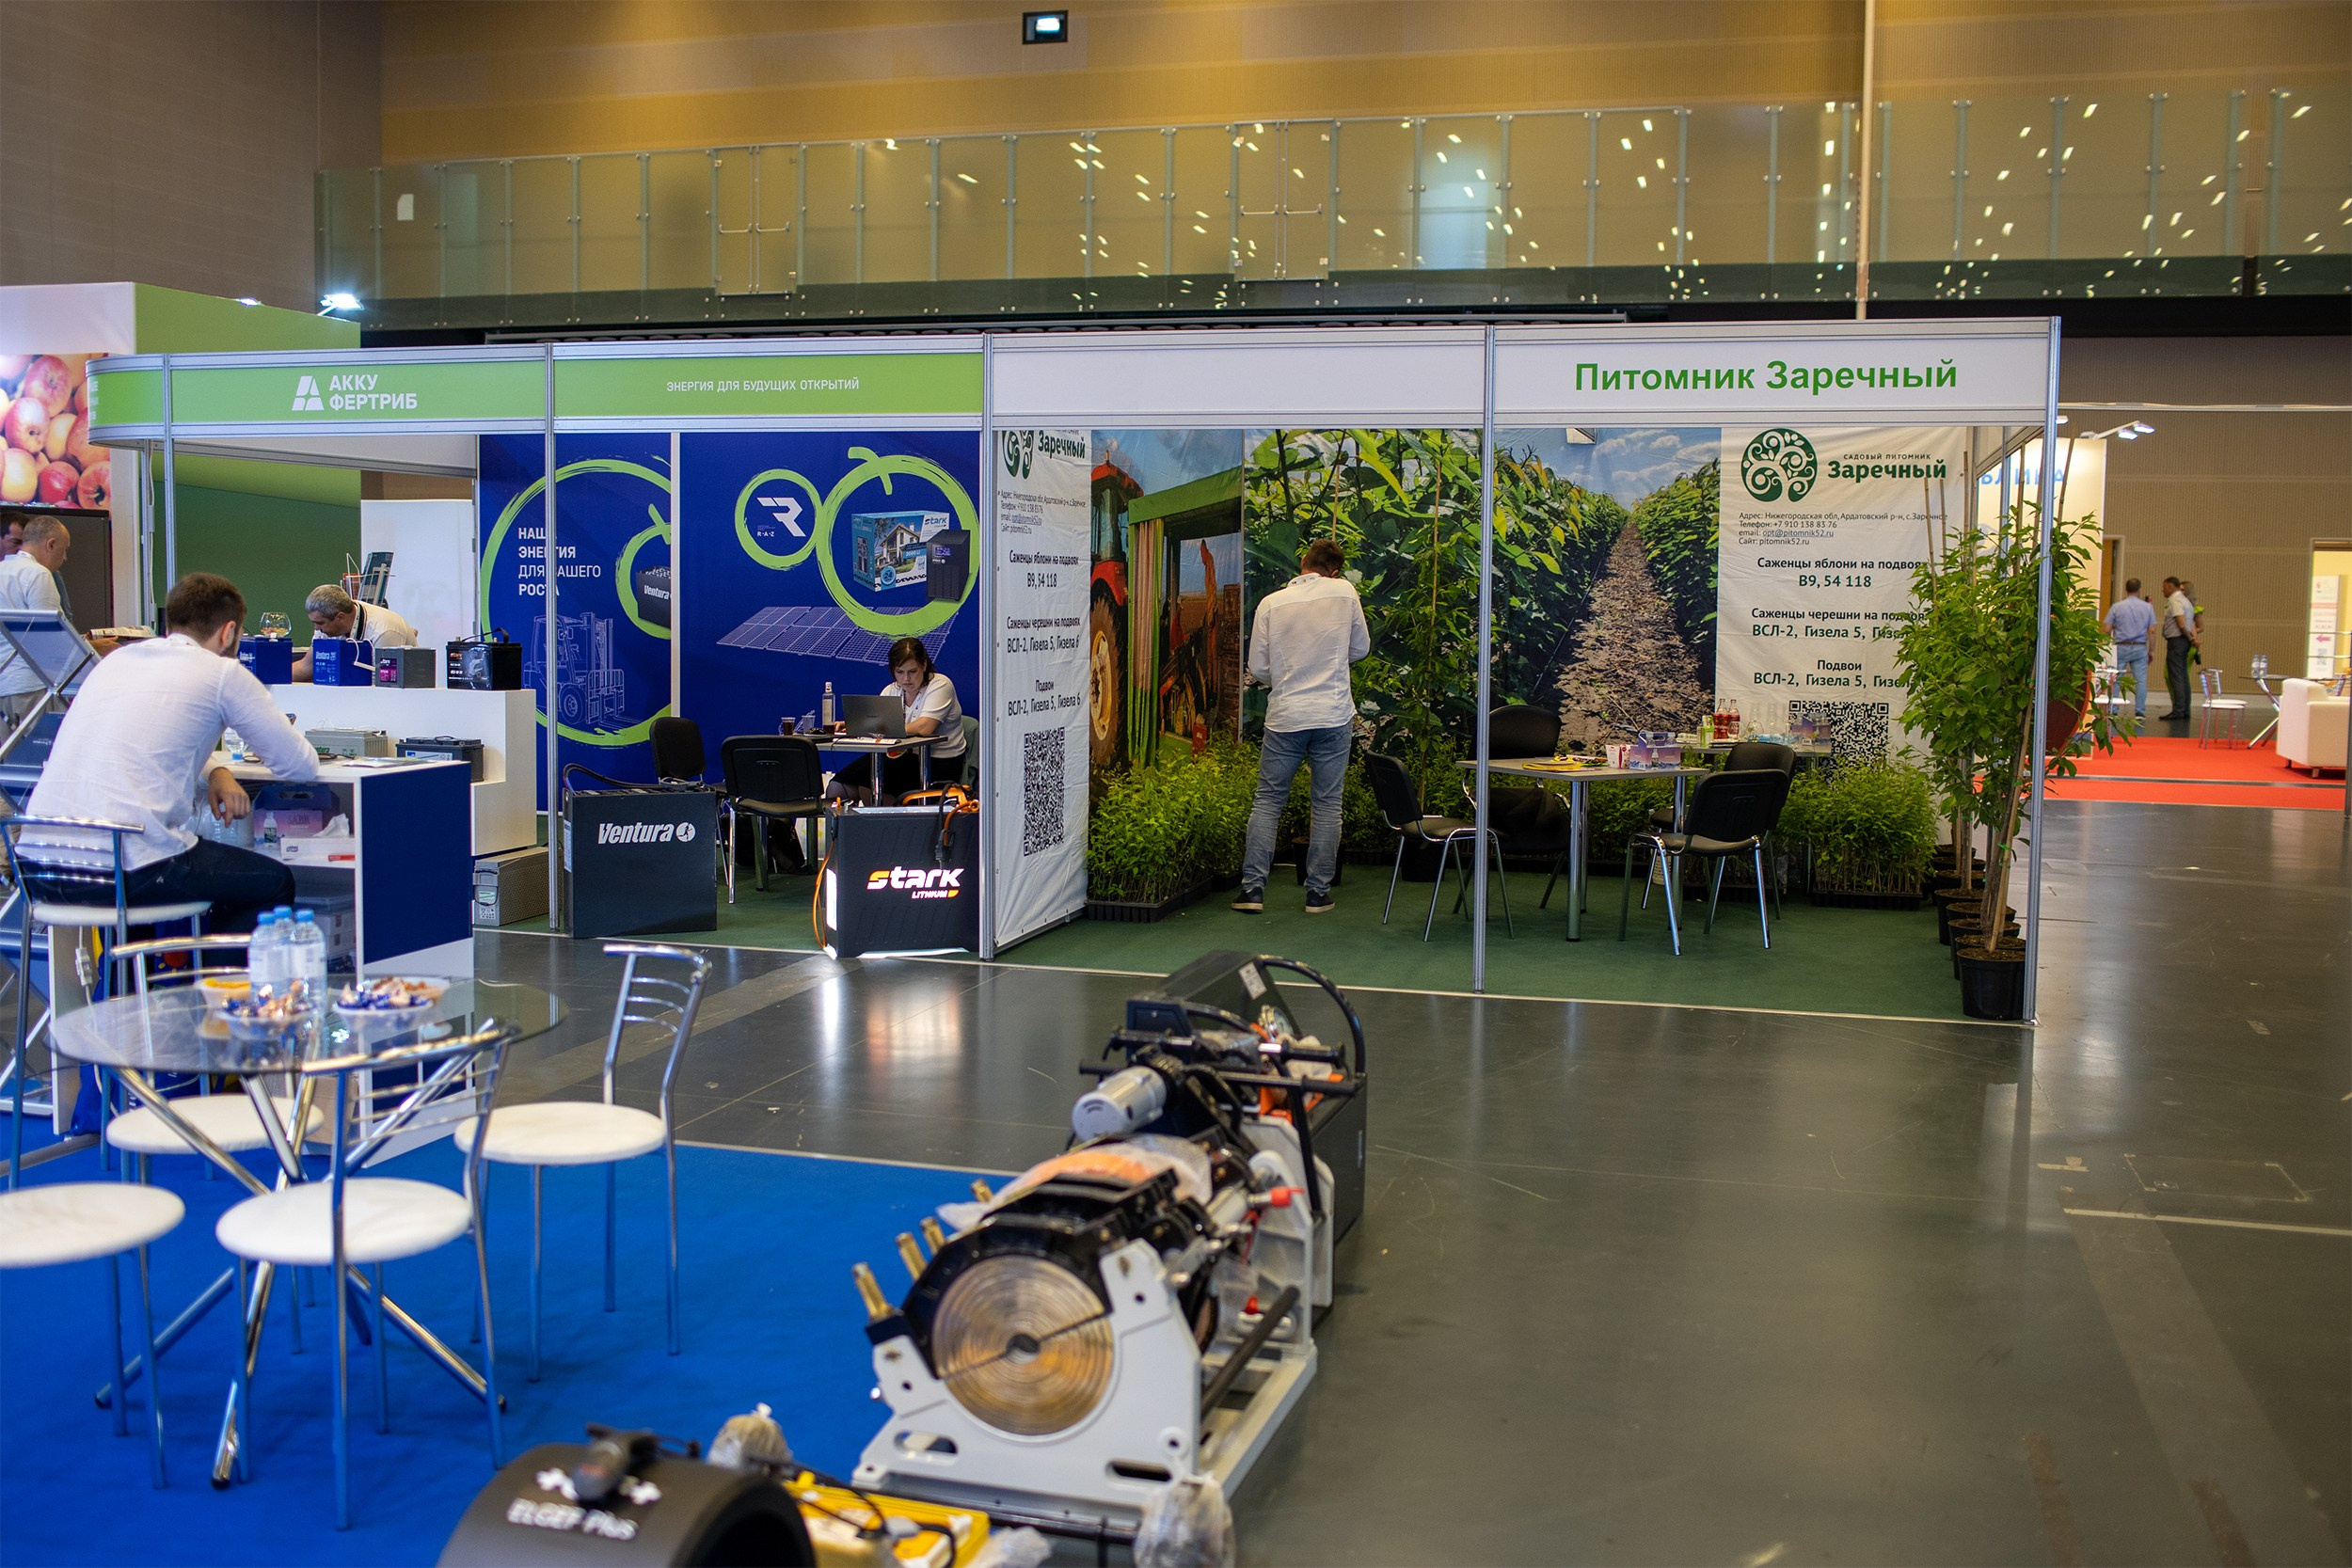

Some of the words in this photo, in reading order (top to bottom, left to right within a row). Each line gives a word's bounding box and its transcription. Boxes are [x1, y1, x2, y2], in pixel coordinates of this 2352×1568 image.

[329, 374, 378, 390] АККУ
[666, 381, 714, 392] ЭНЕРГИЯ
[717, 380, 739, 392] ДЛЯ
[743, 380, 797, 392] БУДУЩИХ
[800, 376, 859, 390] ОТКРЫТИЙ
[1575, 363, 1756, 390] Питомник
[1766, 358, 1957, 395] Заречный
[329, 392, 418, 410] ФЕРТРИБ
[1038, 430, 1086, 458] Заречный
[1827, 459, 1947, 483] Заречный
[1739, 512, 1763, 520] Адрес:
[1765, 512, 1823, 521] Нижегородская
[1823, 512, 1839, 521] обл,
[1840, 513, 1889, 521] Ардатовский
[1890, 514, 1905, 522] р-н,
[1739, 520, 1772, 530] Телефон:
[1773, 520, 1784, 529] +7
[1827, 520, 1837, 529] 76
[518, 527, 558, 540] НАШ
[1739, 529, 1761, 537] email:
[1762, 529, 1835, 538] opt@pitomnik52.ru
[1739, 537, 1758, 546] Сайт:
[1759, 537, 1810, 546] pitomnik52.ru
[1009, 549, 1033, 564] Саженцы
[1033, 551, 1052, 564] яблони
[1052, 556, 1059, 565] на
[1059, 555, 1079, 566] подвоях
[1757, 557, 1812, 570] Саженцы
[1814, 558, 1858, 570] яблони
[1860, 560, 1875, 569] на
[518, 564, 545, 578] ДЛЯ
[556, 564, 602, 578] АШЕГО
[1046, 572, 1057, 588] 118
[1823, 576, 1841, 587] 54
[1846, 576, 1872, 588] 118
[644, 583, 670, 600] Ventura
[1751, 608, 1805, 621] Саженцы
[1808, 610, 1861, 623] черешни
[1864, 611, 1878, 621] на
[1007, 616, 1031, 629] Саженцы
[1031, 617, 1053, 633] черешни
[1054, 618, 1060, 627] на
[1060, 616, 1081, 629] подвоях
[1752, 625, 1799, 639] ВСЛ-2,
[1804, 625, 1849, 638] Гизела
[1853, 624, 1866, 640] 5,
[1007, 638, 1028, 654] ВСЛ-2,
[1030, 637, 1049, 652] Гизела
[1050, 636, 1056, 652] 5,
[1057, 635, 1075, 650] Гизела
[1075, 635, 1080, 648] 6
[1817, 659, 1863, 673] Подвои
[1035, 679, 1055, 693] Подвои
[1753, 672, 1800, 688] ВСЛ-2,
[1805, 673, 1851, 687] Гизела
[1854, 673, 1867, 689] 5,
[1008, 699, 1028, 717] ВСЛ-2,
[1030, 696, 1050, 713] Гизела
[1050, 695, 1057, 711] 5,
[1057, 694, 1076, 709] Гизела
[1076, 692, 1081, 706] 6
[598, 822, 674, 845] Ventura
[866, 865, 964, 890] stark
[911, 889, 948, 899] LITHIUM
